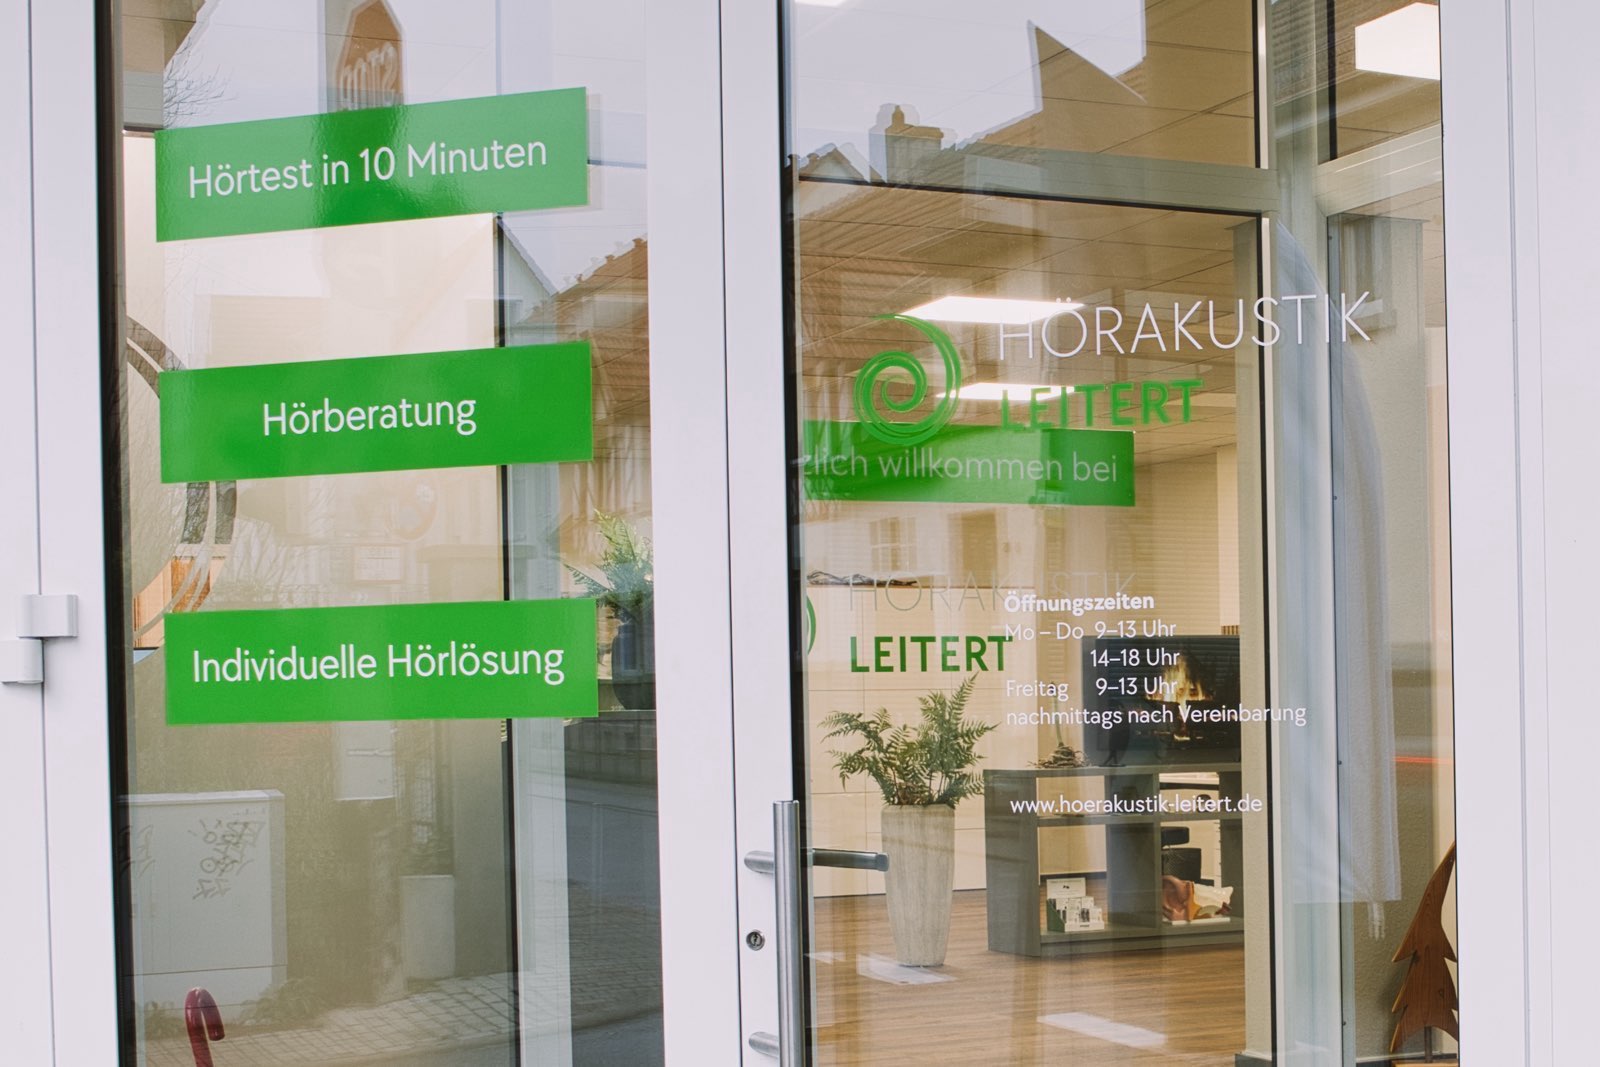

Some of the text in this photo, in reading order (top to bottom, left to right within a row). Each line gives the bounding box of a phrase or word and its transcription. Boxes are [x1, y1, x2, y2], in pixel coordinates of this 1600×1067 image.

[188, 139, 547, 199] Hörtest in 10 Minuten
[1000, 291, 1371, 360] HÖRAKUSTIK
[263, 397, 477, 437] Hörberatung
[1001, 379, 1204, 431] LEITERT
[879, 446, 1062, 482] willkommen
[1073, 451, 1118, 483] bei
[1004, 592, 1155, 616] Öffnungszeiten
[1005, 623, 1034, 641] Mo
[1056, 621, 1084, 640] Do
[1142, 619, 1177, 638] Uhr
[193, 641, 564, 685] Individuelle Hörlösung
[850, 635, 1013, 673] LEITERT
[1146, 647, 1181, 666] Uhr
[1006, 679, 1069, 702] Freitag
[1144, 676, 1178, 695] Uhr
[1007, 703, 1307, 729] nachmittags nach Vereinbarung
[1010, 793, 1263, 814] www.hoerakustik-leitert.de
